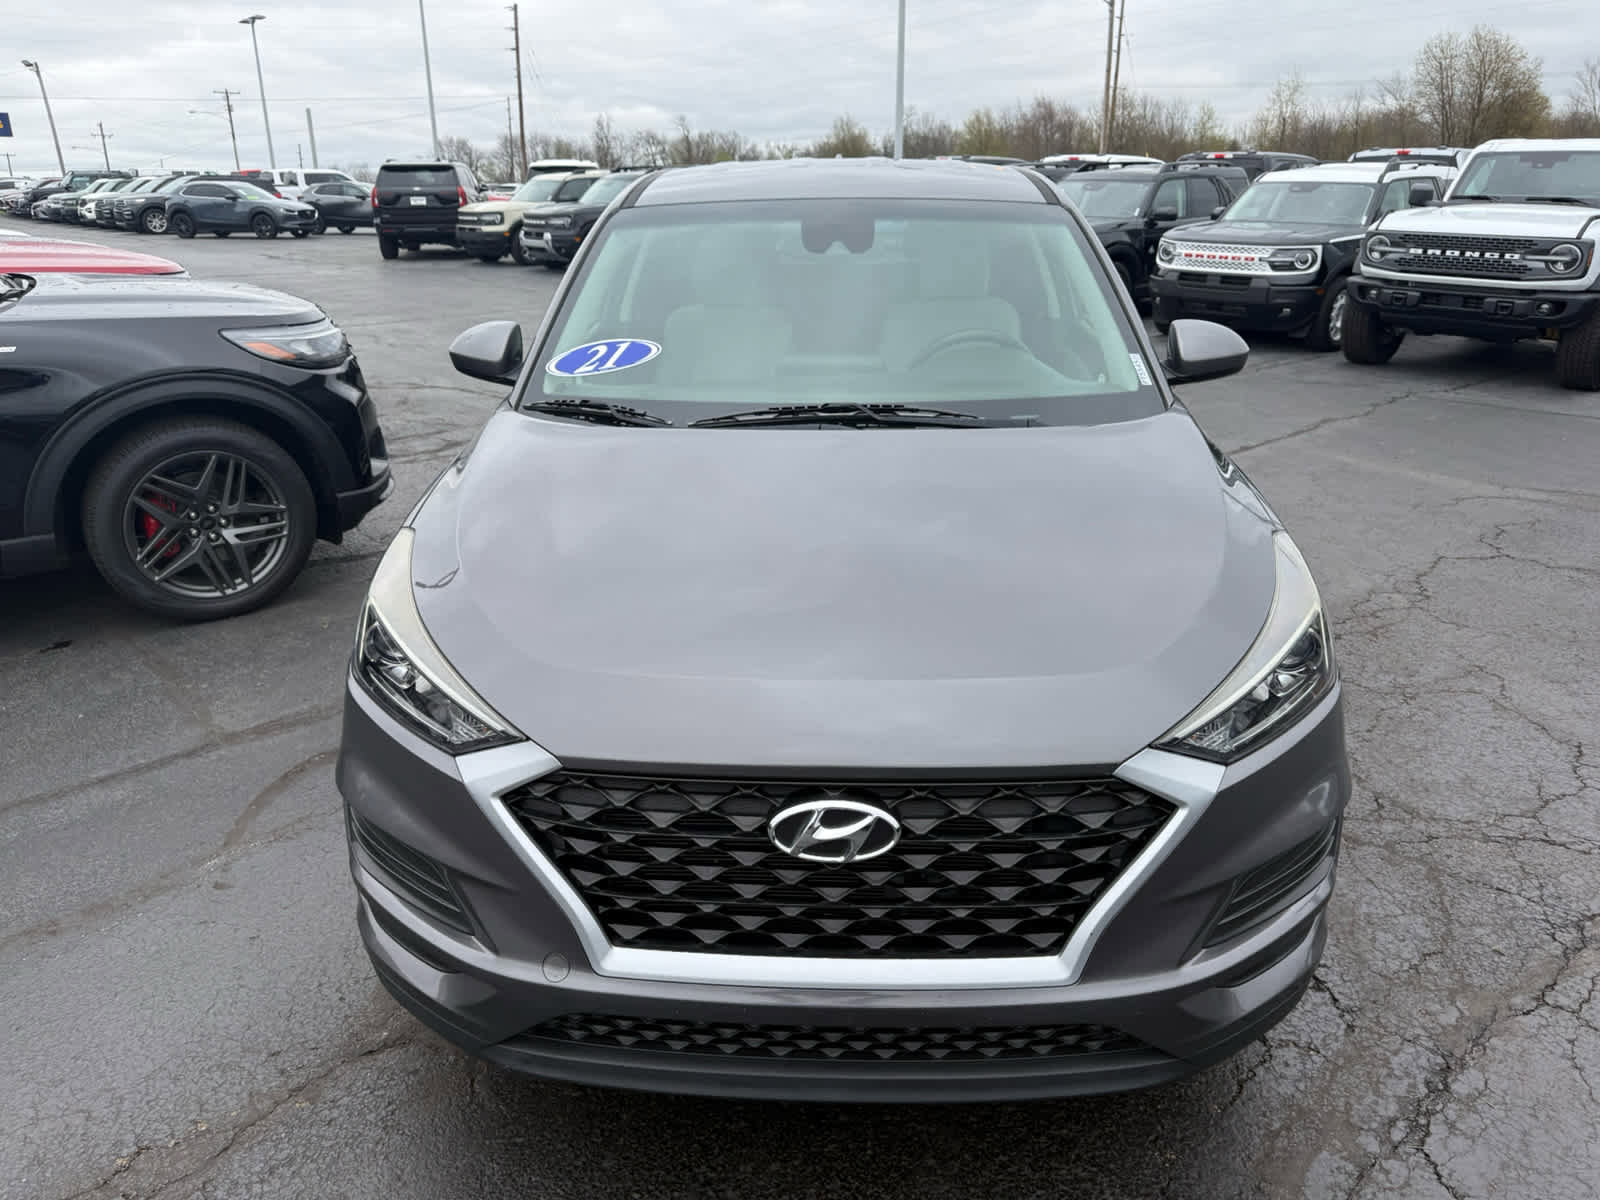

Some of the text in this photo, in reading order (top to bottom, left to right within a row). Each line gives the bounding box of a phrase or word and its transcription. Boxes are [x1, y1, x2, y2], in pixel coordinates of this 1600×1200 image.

[1183, 252, 1256, 262] BRONCO
[1408, 247, 1520, 260] BRONCO
[573, 341, 631, 374] 21
